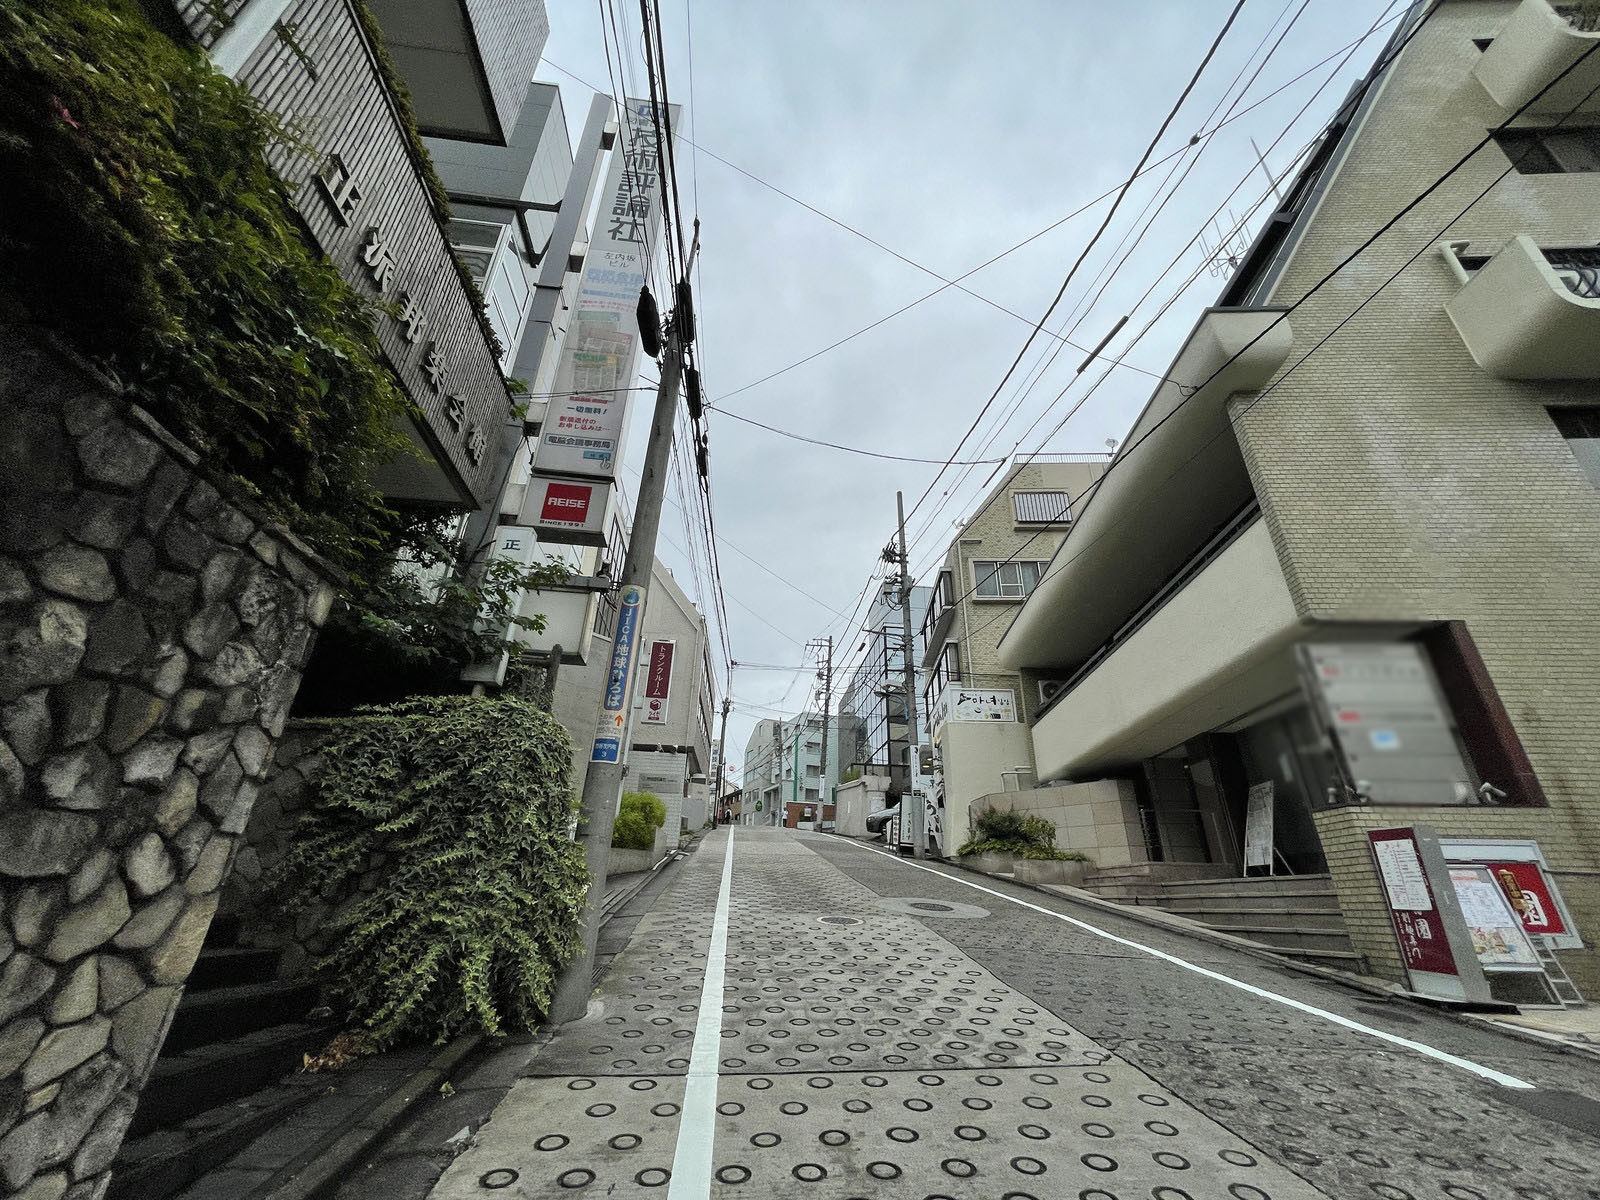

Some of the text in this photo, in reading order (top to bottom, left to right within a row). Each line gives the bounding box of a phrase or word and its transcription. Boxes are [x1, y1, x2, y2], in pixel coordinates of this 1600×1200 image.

[547, 497, 586, 509] REISE
[652, 645, 666, 696] トランクルーム
